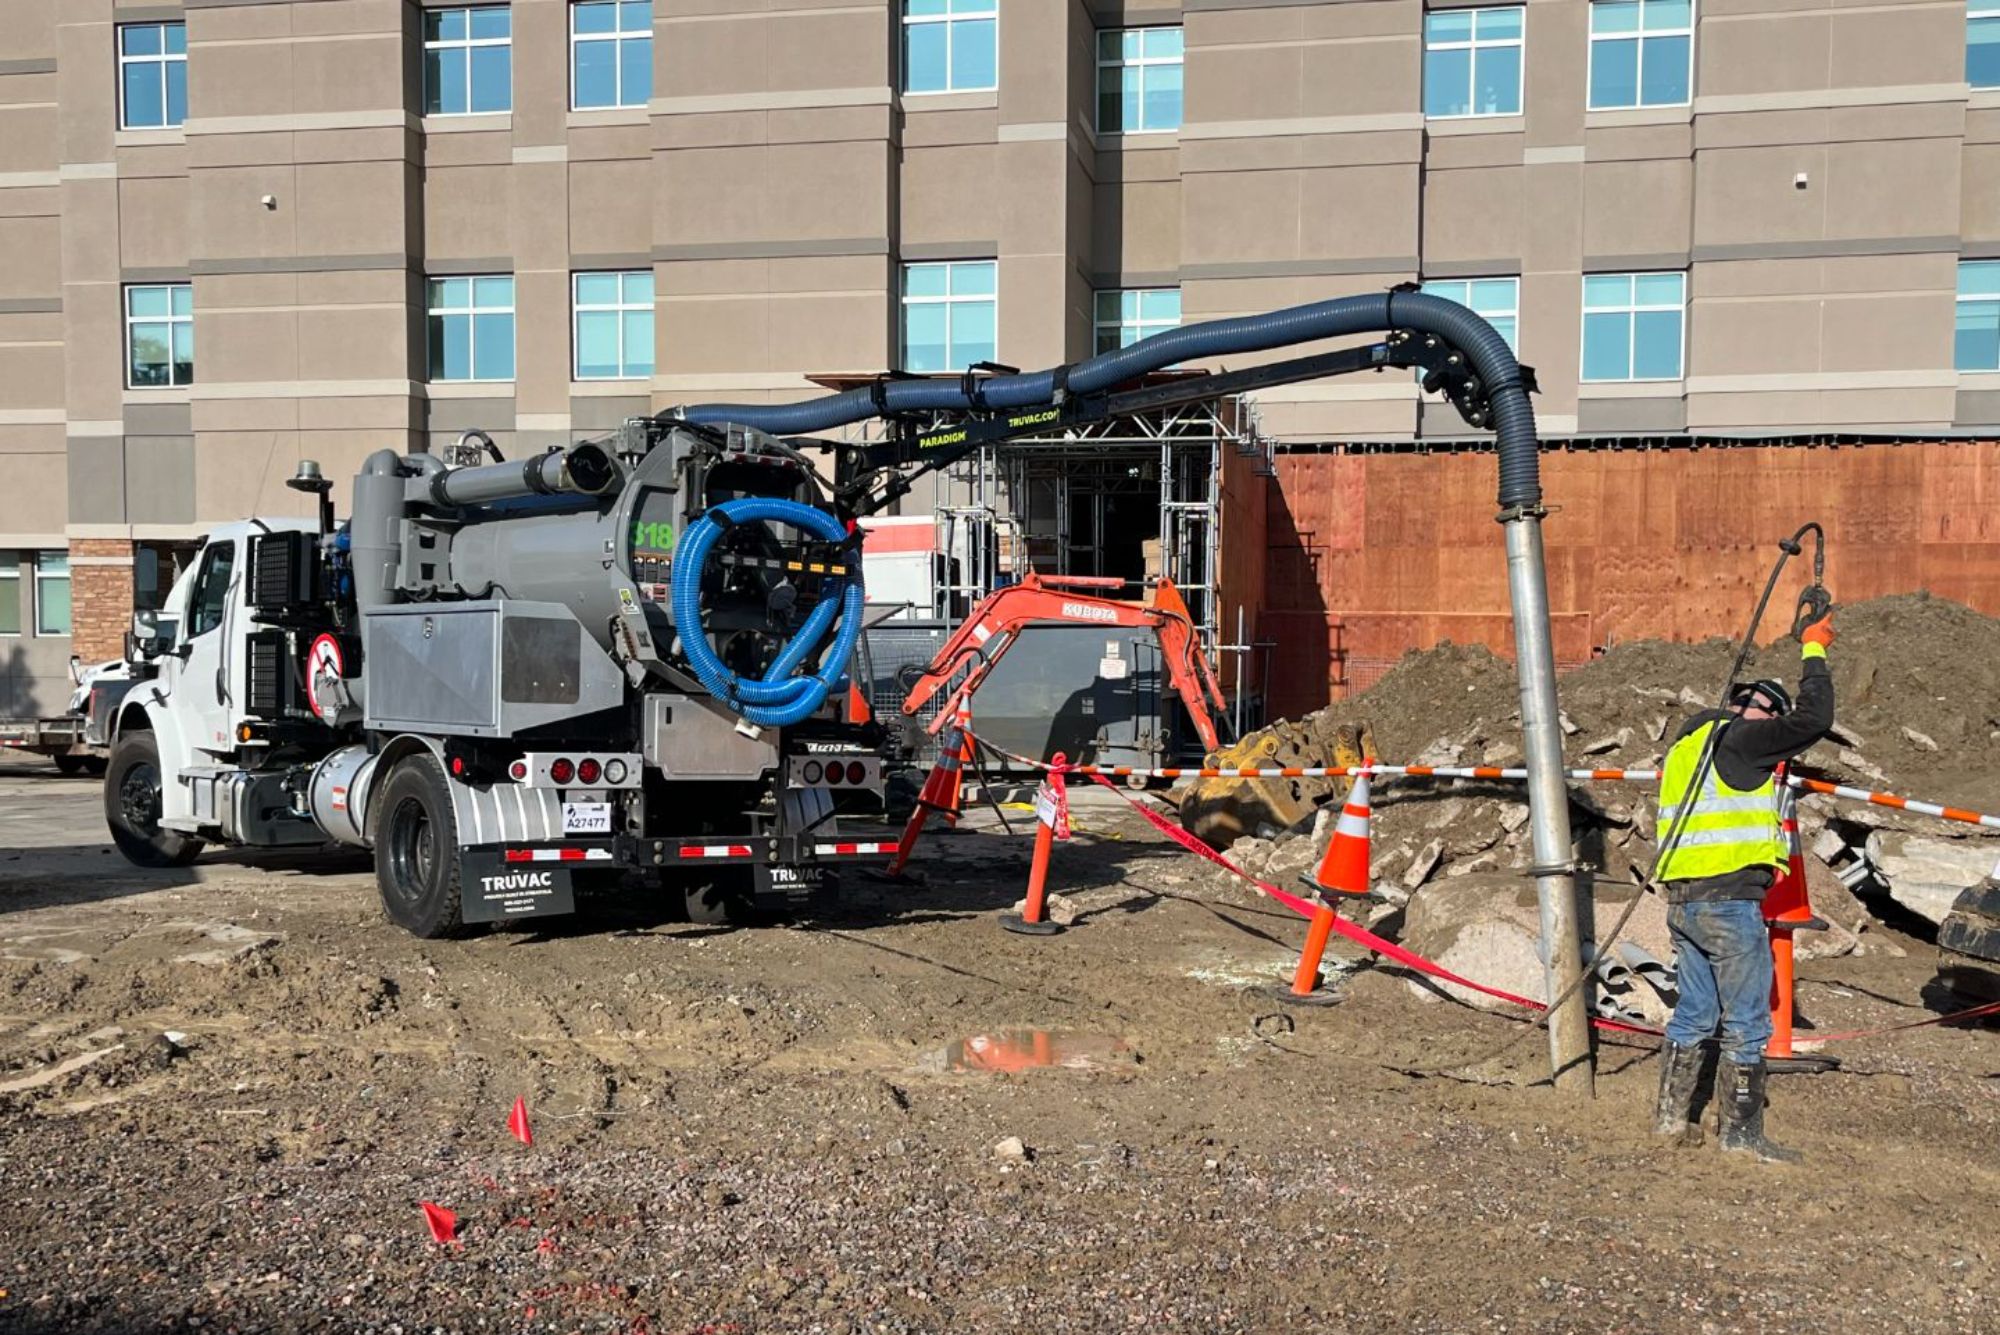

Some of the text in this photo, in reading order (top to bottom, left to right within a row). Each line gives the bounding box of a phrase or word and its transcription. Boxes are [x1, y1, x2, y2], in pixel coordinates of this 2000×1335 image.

[919, 431, 967, 448] PARADIGM
[567, 817, 605, 828] A27477
[480, 871, 552, 892] TRUVAC
